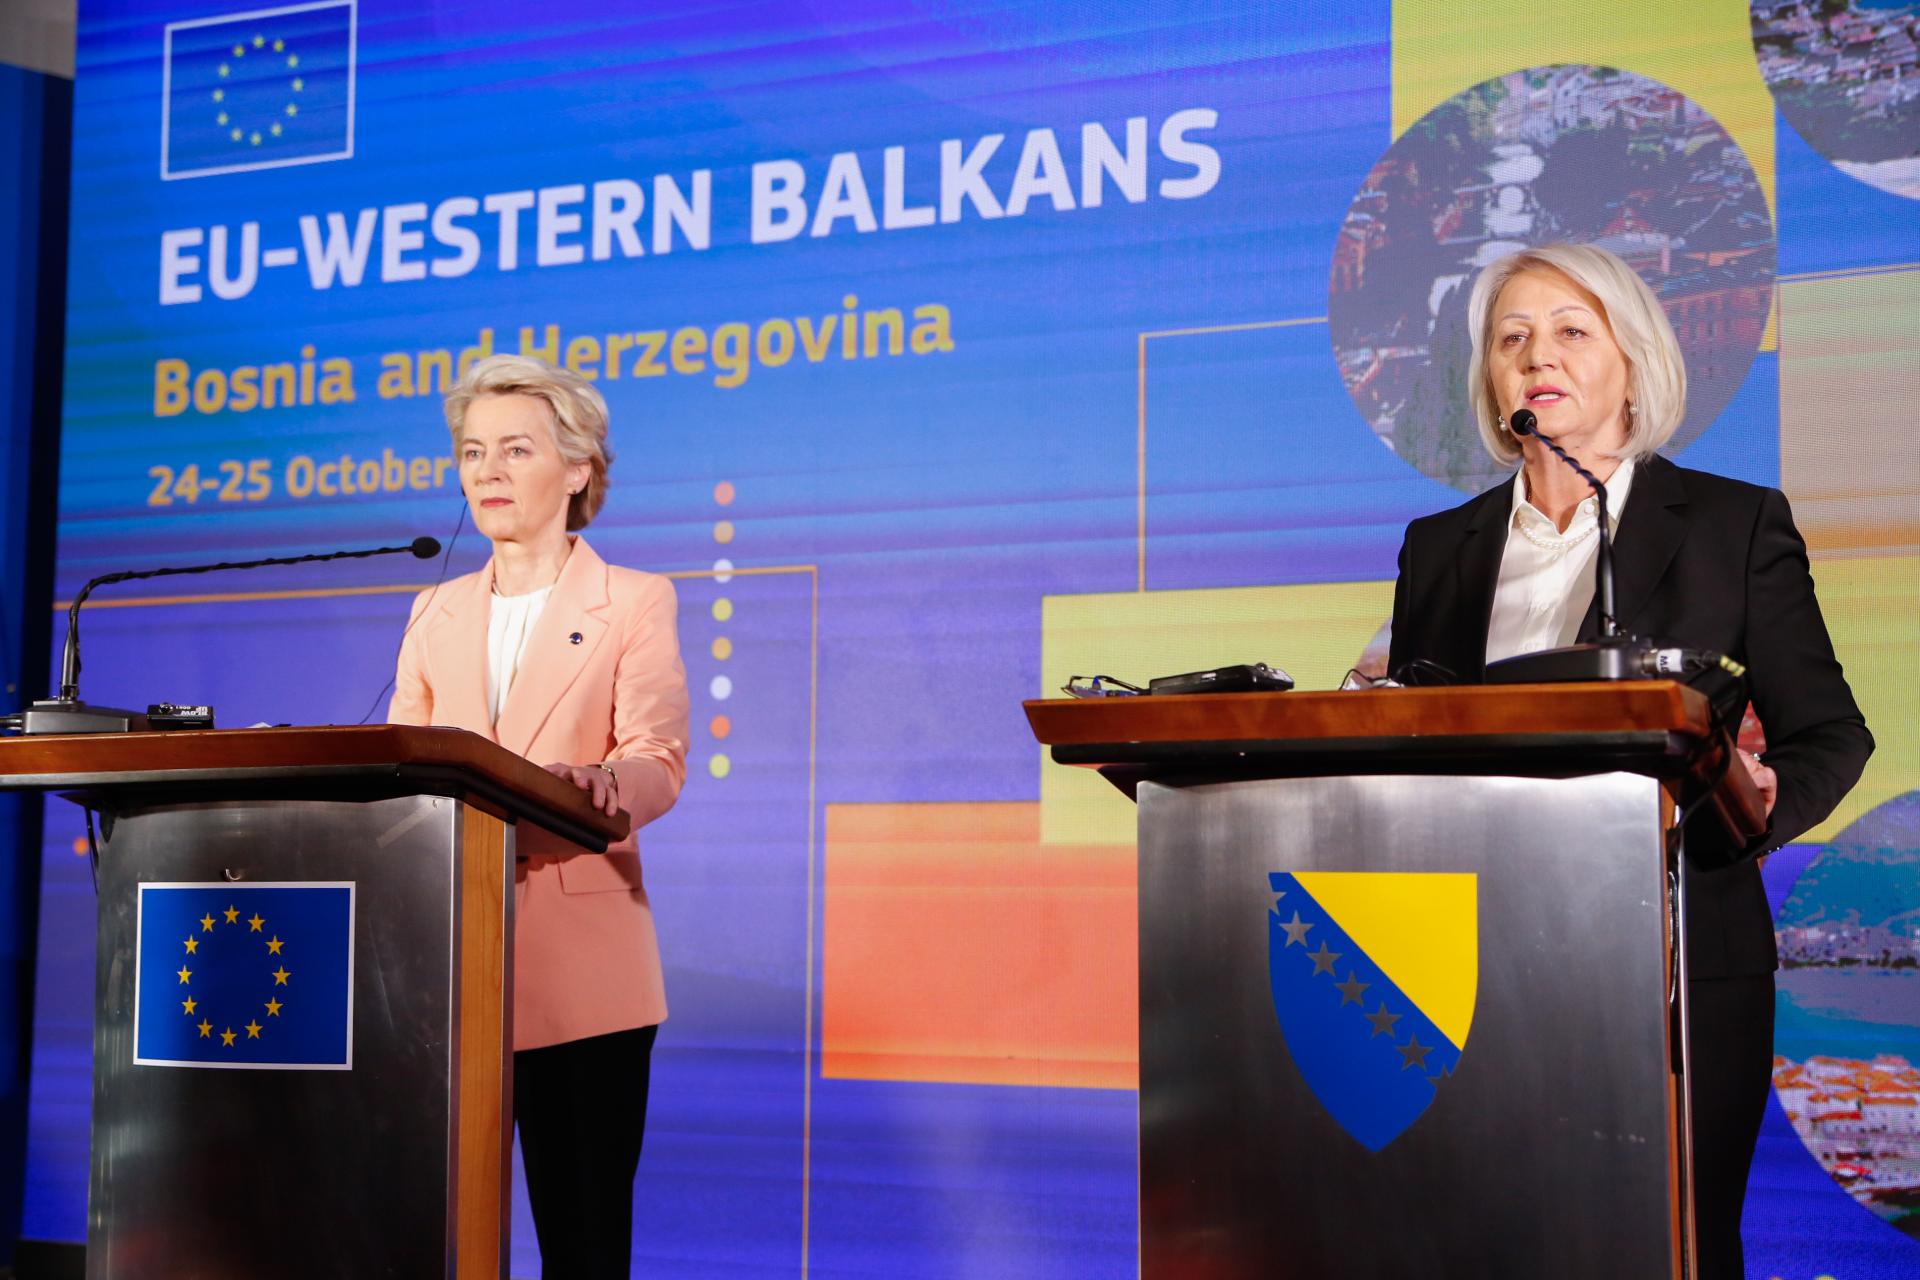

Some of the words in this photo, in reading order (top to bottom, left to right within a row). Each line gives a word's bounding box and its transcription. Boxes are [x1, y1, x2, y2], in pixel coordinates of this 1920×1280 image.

[160, 169, 711, 305] EU-WESTERN
[751, 108, 1221, 243] BALKANS
[154, 345, 355, 417] Bosnia
[519, 295, 955, 388] Herzegovina
[149, 459, 272, 506] 24-25
[285, 448, 452, 498] October
